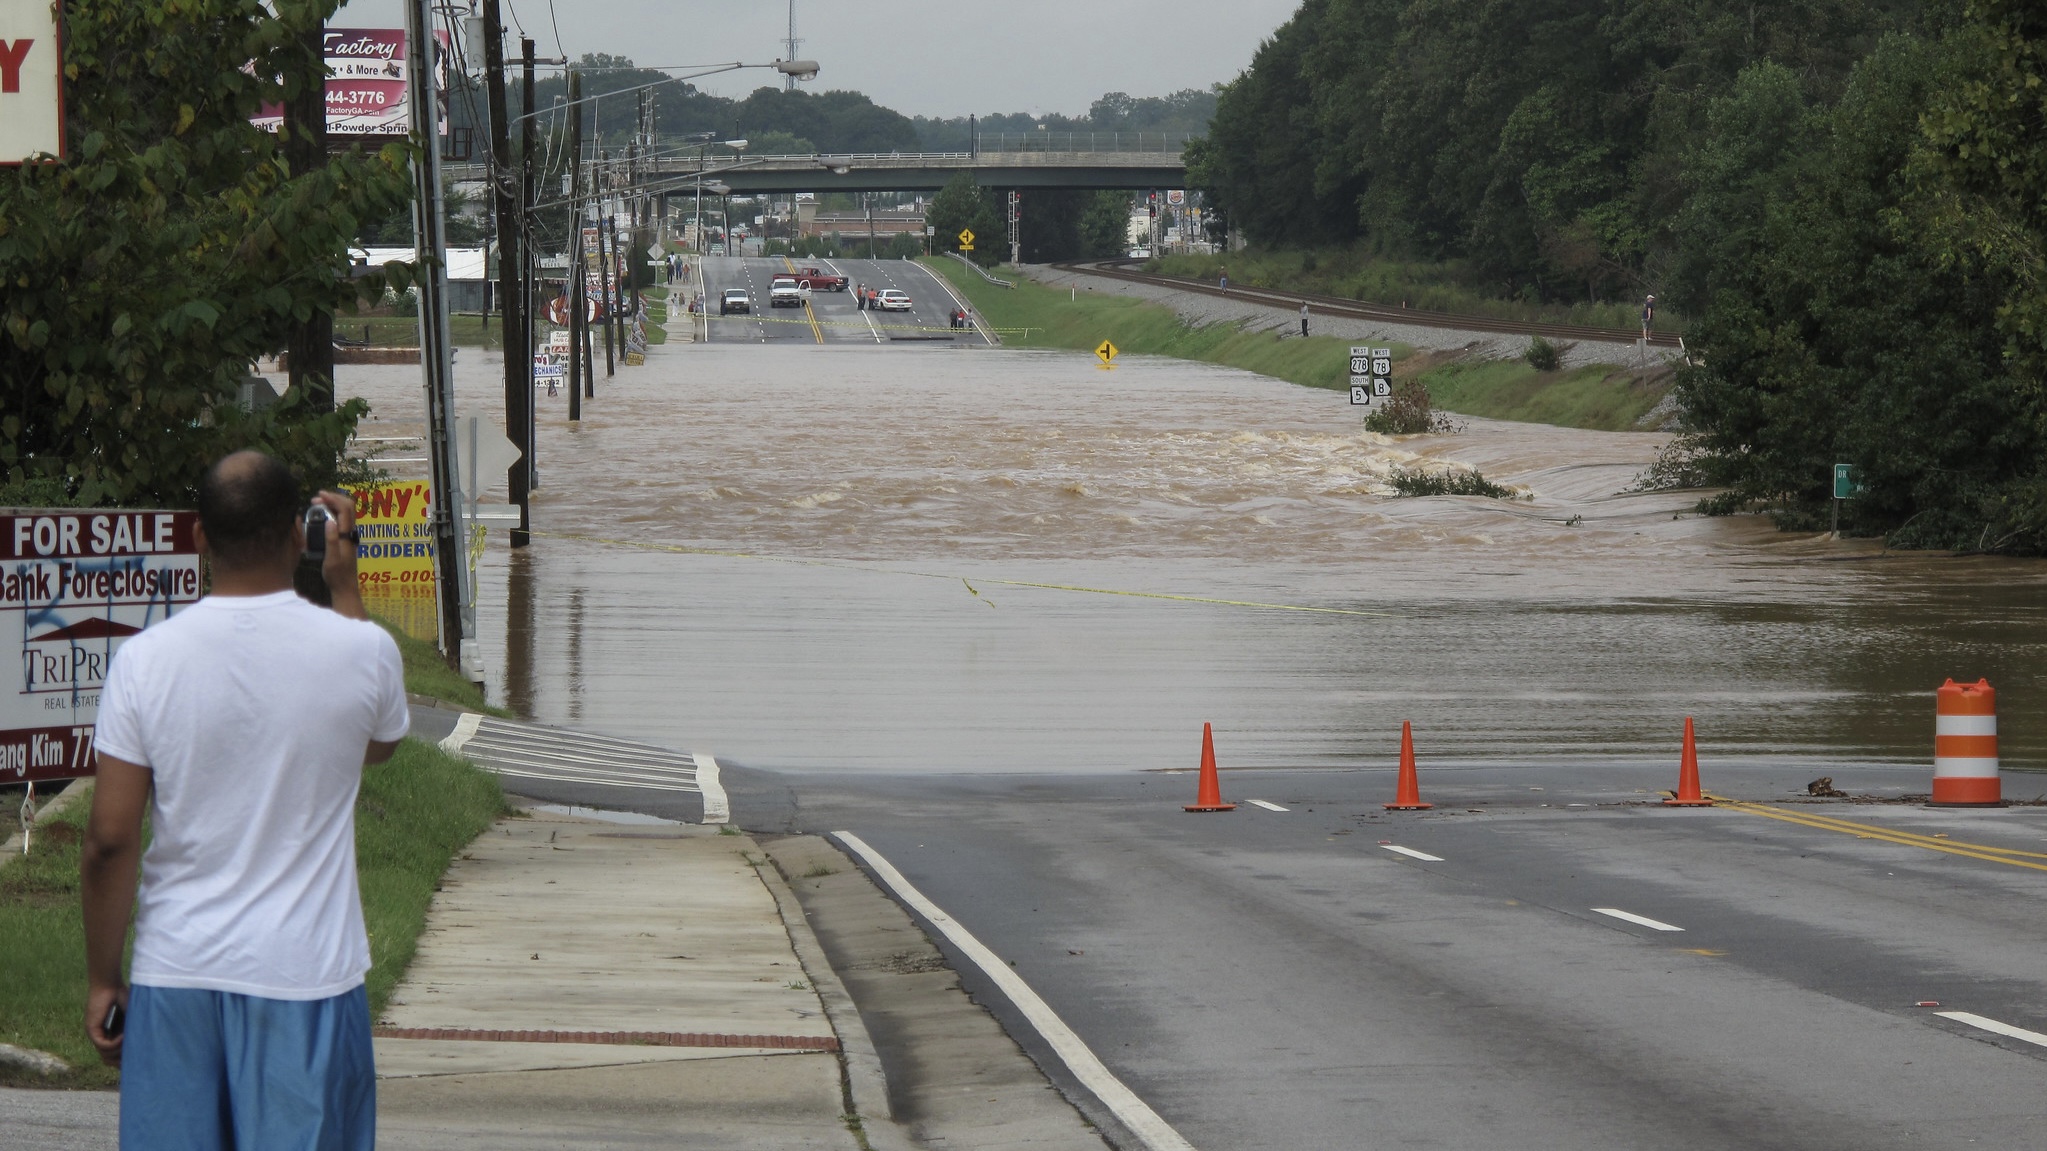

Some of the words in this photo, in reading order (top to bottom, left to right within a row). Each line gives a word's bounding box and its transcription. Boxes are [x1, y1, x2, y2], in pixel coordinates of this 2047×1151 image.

[0, 39, 35, 93] Y
[356, 65, 378, 75] More
[326, 90, 385, 105] 44-3776
[1352, 360, 1366, 370] 278
[1376, 362, 1386, 373] 78
[1356, 390, 1362, 400] 5
[1378, 384, 1384, 394] 8
[14, 517, 81, 556] FOR
[90, 514, 174, 555] SALE
[403, 524, 410, 538] &
[413, 523, 433, 538] SIG
[59, 561, 196, 600] Foreclosure
[45, 698, 66, 710] REAL
[32, 734, 64, 768] Kim
[72, 728, 98, 768] 77
